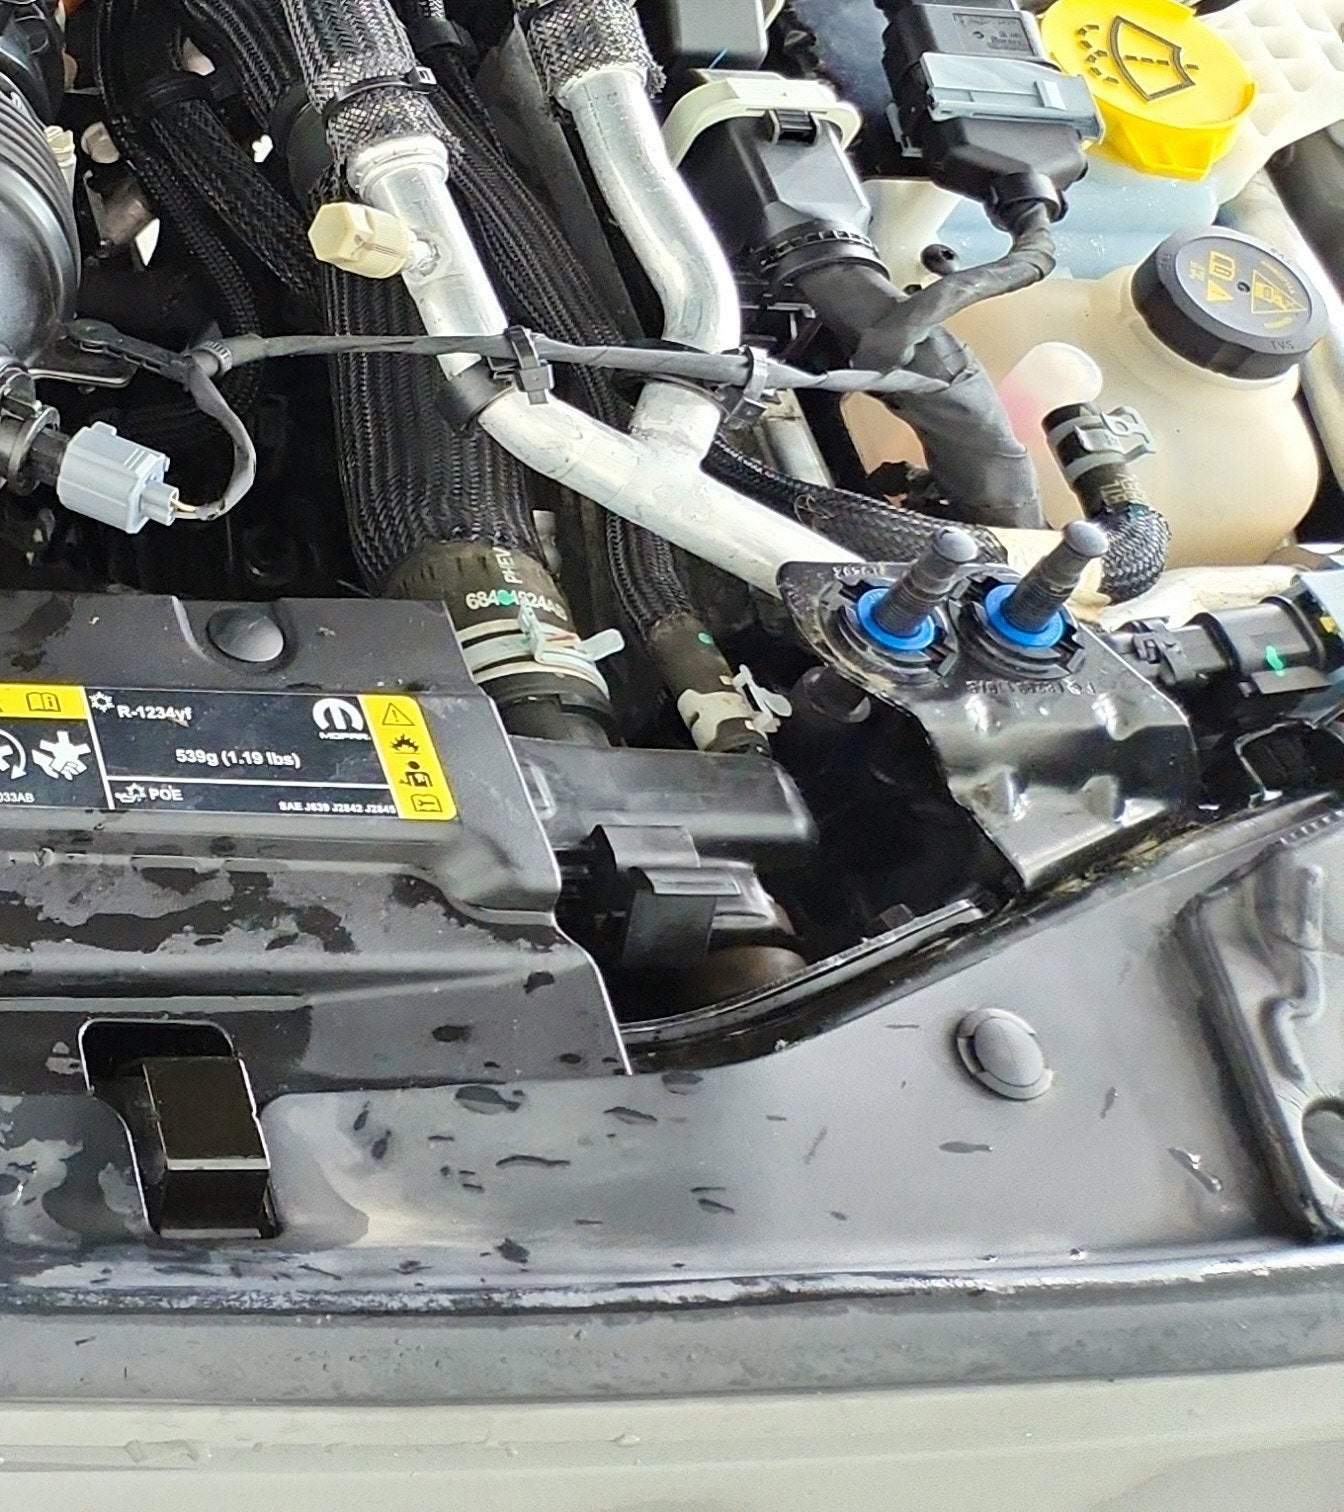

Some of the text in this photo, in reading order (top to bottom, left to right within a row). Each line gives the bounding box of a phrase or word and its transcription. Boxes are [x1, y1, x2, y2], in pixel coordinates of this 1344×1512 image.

[493, 546, 524, 585] PHEV
[116, 703, 194, 722] R-1234yf
[175, 748, 302, 770] 539g (1.19 lbs)
[148, 786, 185, 803] POE
[278, 799, 303, 812] SAE
